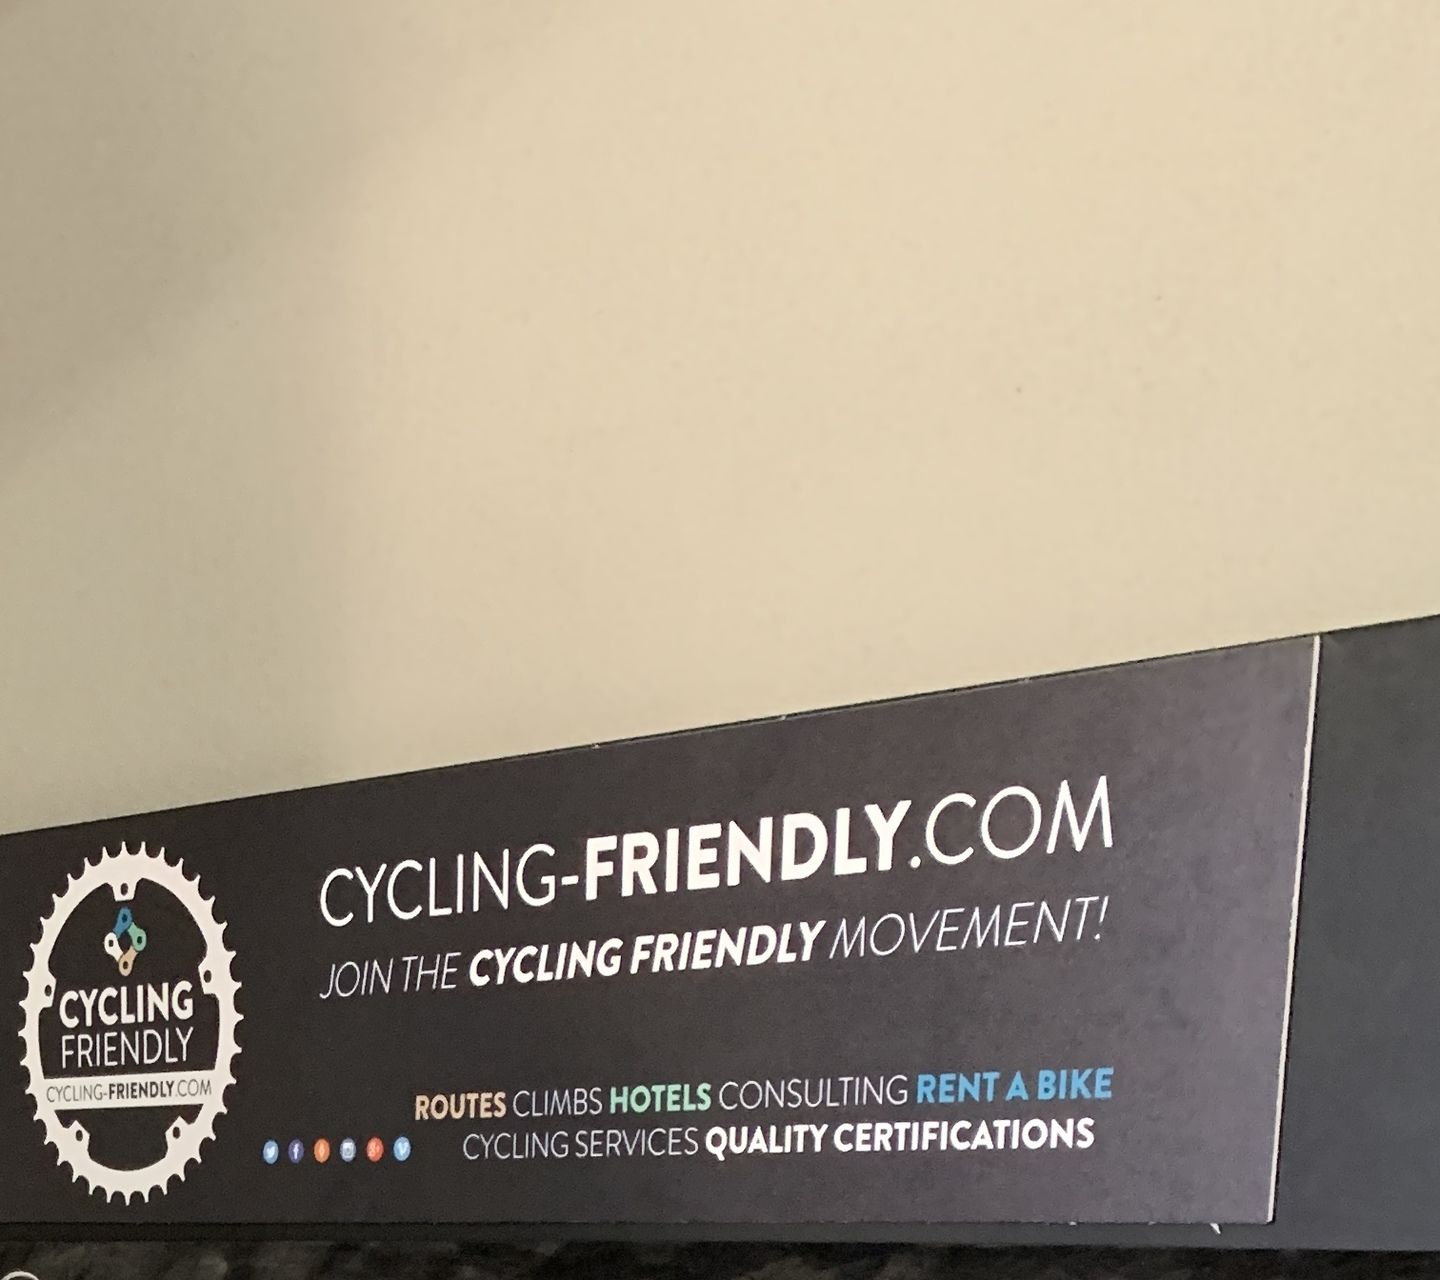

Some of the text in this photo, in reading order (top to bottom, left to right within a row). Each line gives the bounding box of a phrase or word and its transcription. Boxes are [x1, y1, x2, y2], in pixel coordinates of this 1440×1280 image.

[319, 775, 1114, 927] CYCLING-FRIENDLY.COM
[319, 895, 1110, 1000] JOIN THE CYCLING FRIENDLY MOVEMENT!
[59, 980, 194, 1029] CYCLING
[61, 1026, 194, 1069] FRIENDLY
[46, 1079, 212, 1103] CYCLING-FRIENDLY.COM
[414, 1065, 1115, 1121] ROUTES CLIMBS HOTELS CONSULTING RENT A BIKE
[462, 1116, 1096, 1162] CYCLING SERVICES QUALITY CERTIFICATIONS
